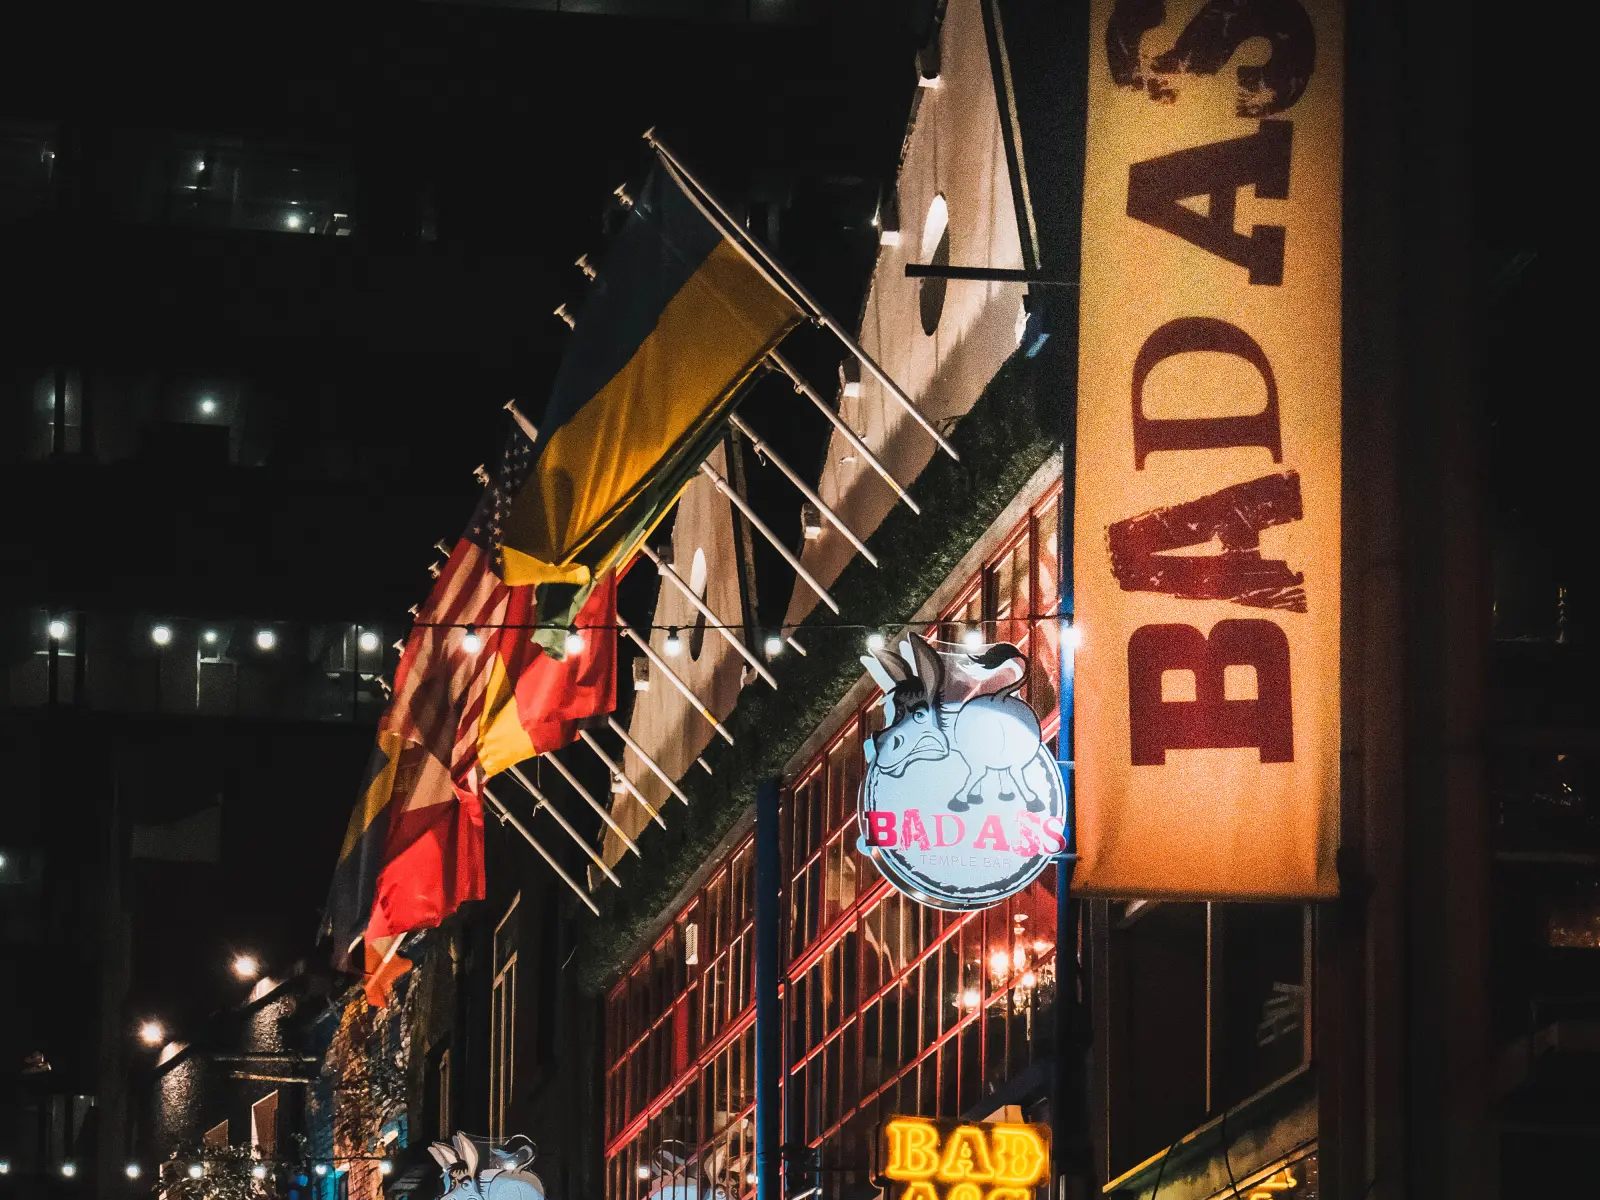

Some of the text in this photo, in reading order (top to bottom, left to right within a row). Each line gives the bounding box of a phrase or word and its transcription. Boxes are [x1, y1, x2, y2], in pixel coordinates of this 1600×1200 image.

[919, 854, 1012, 869] TEMPLE BAR
[886, 1121, 1045, 1182] BAD
